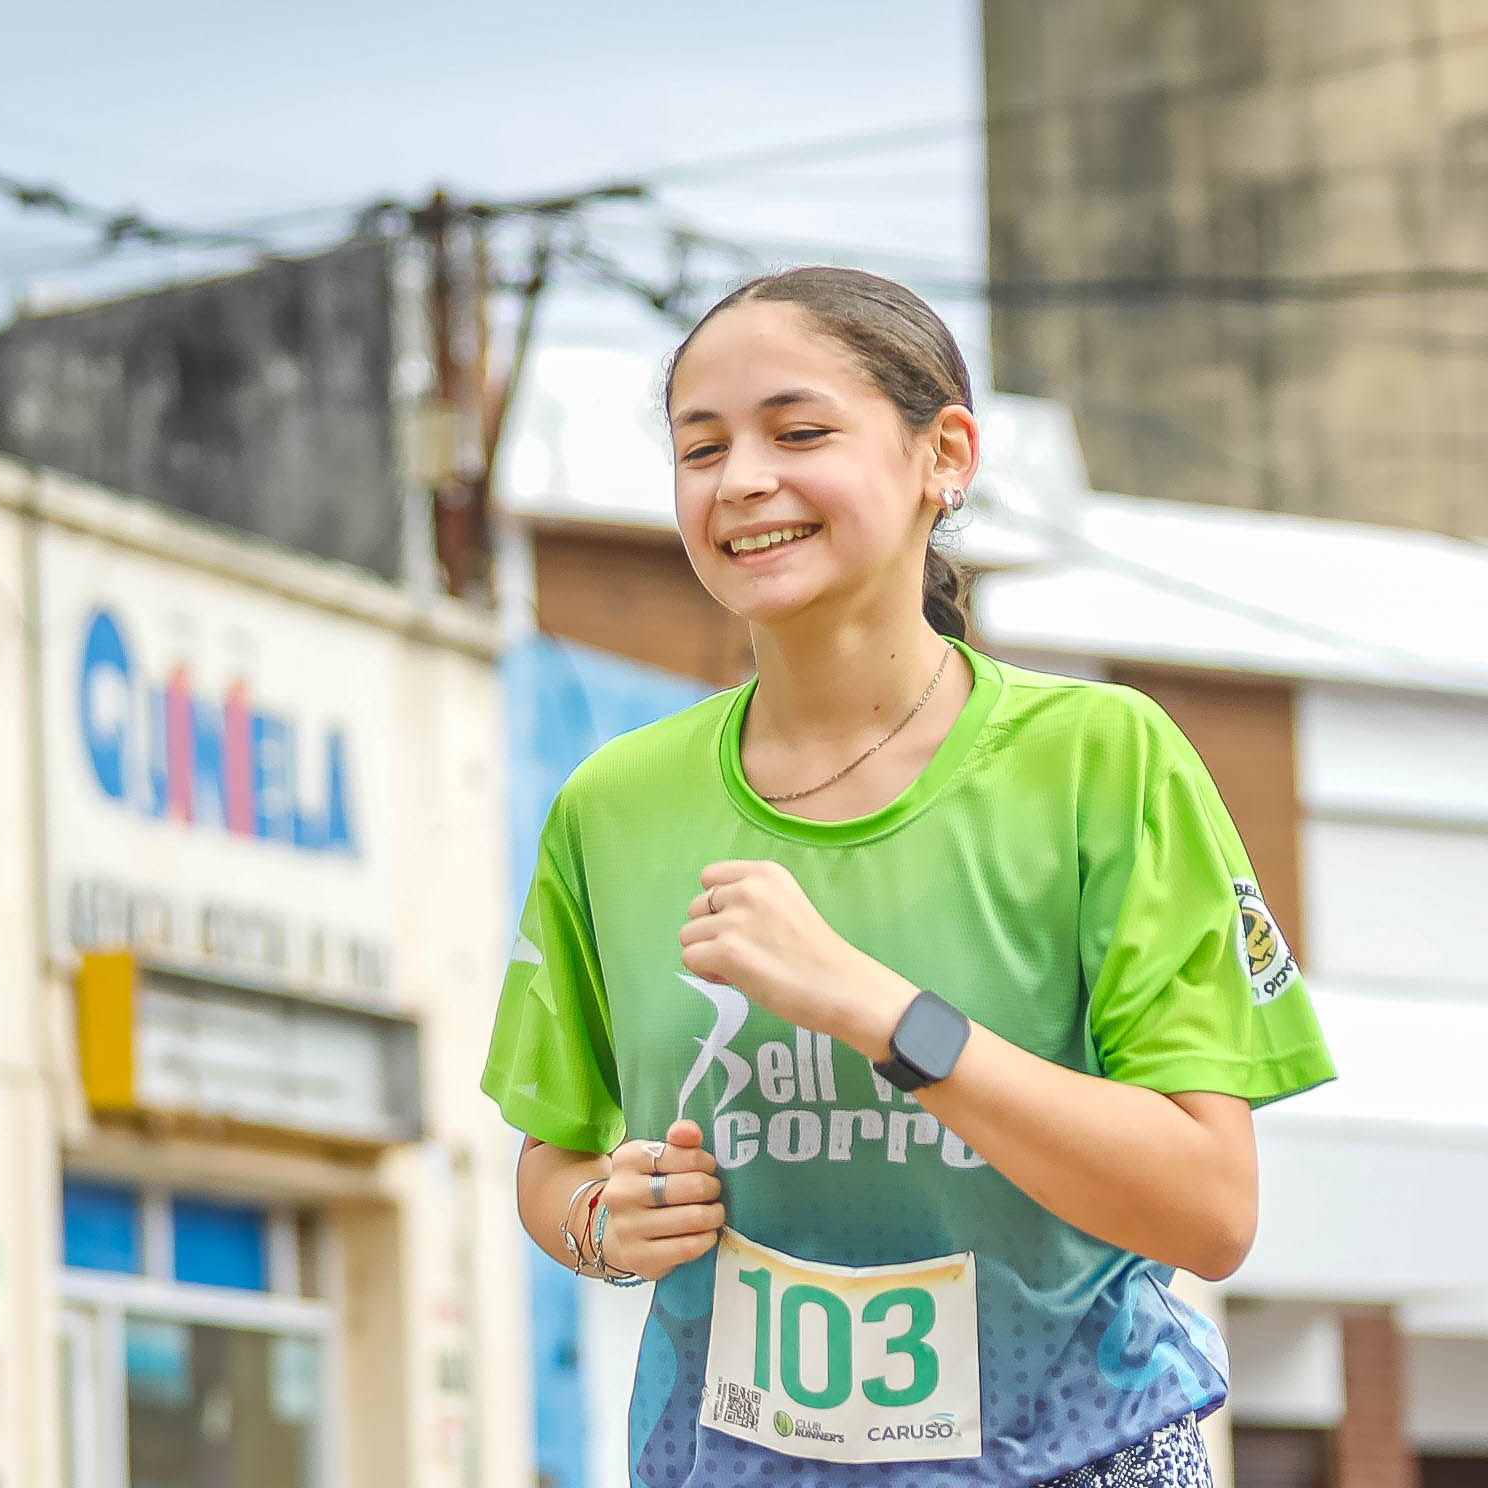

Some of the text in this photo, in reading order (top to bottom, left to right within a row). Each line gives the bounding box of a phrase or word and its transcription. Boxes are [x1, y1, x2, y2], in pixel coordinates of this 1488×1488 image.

[739, 1267, 940, 1410] 103
[795, 1418, 822, 1431] CLUB
[867, 1422, 953, 1442] CARUSO
